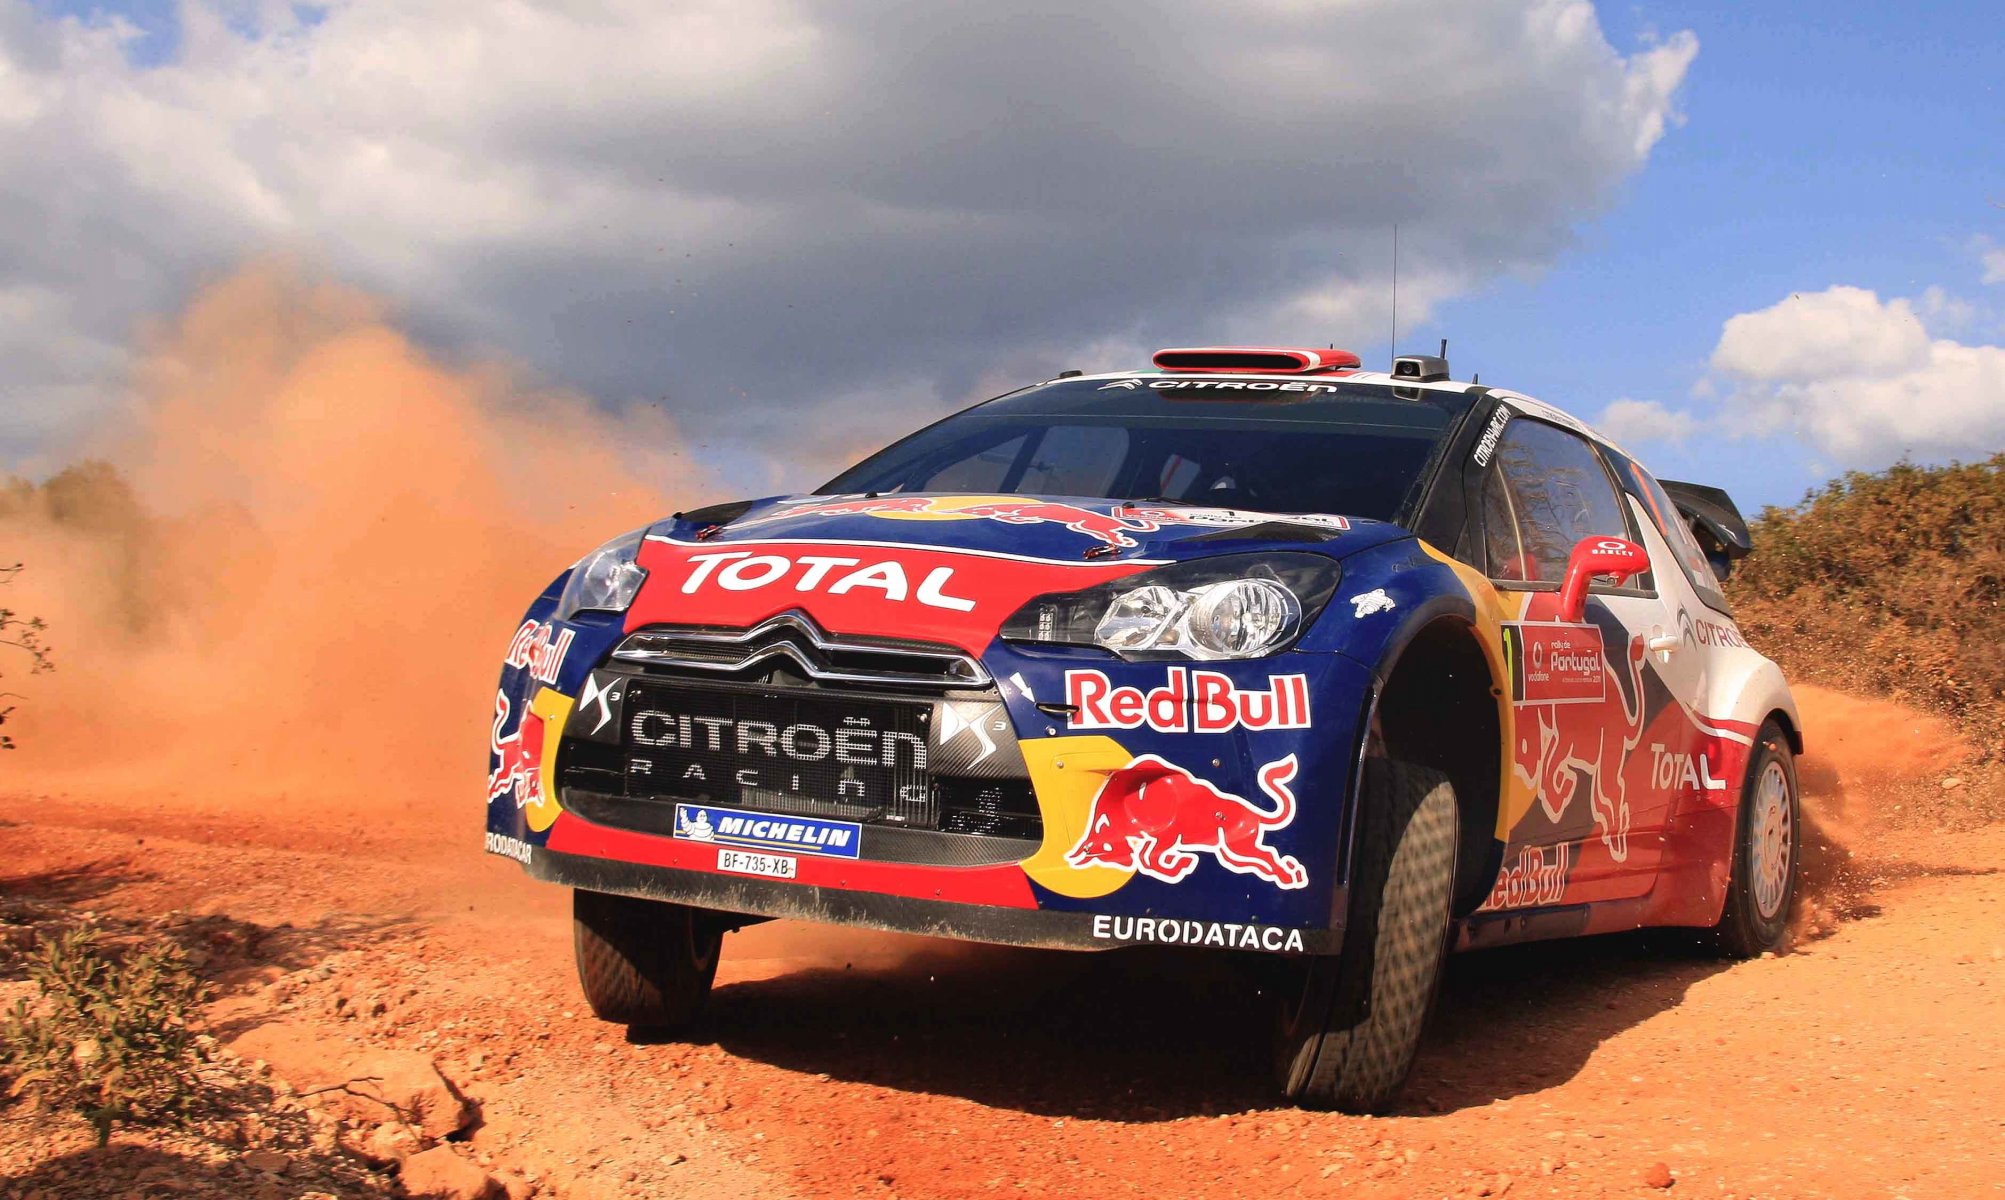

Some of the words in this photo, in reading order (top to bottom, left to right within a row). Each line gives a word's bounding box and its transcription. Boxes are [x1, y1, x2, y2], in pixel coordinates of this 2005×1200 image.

[1591, 549, 1634, 557] OAKLEY
[681, 551, 976, 613] TOTAL
[1527, 670, 1550, 682] vodafone
[1550, 651, 1601, 675] Portugal
[1065, 666, 1188, 733] Red
[1192, 668, 1311, 733] Bull
[1651, 743, 1727, 790] TOTAL
[717, 816, 851, 847] MICHELIN
[724, 852, 789, 875] BF-735-XB
[1092, 914, 1304, 952] EURODATACA
